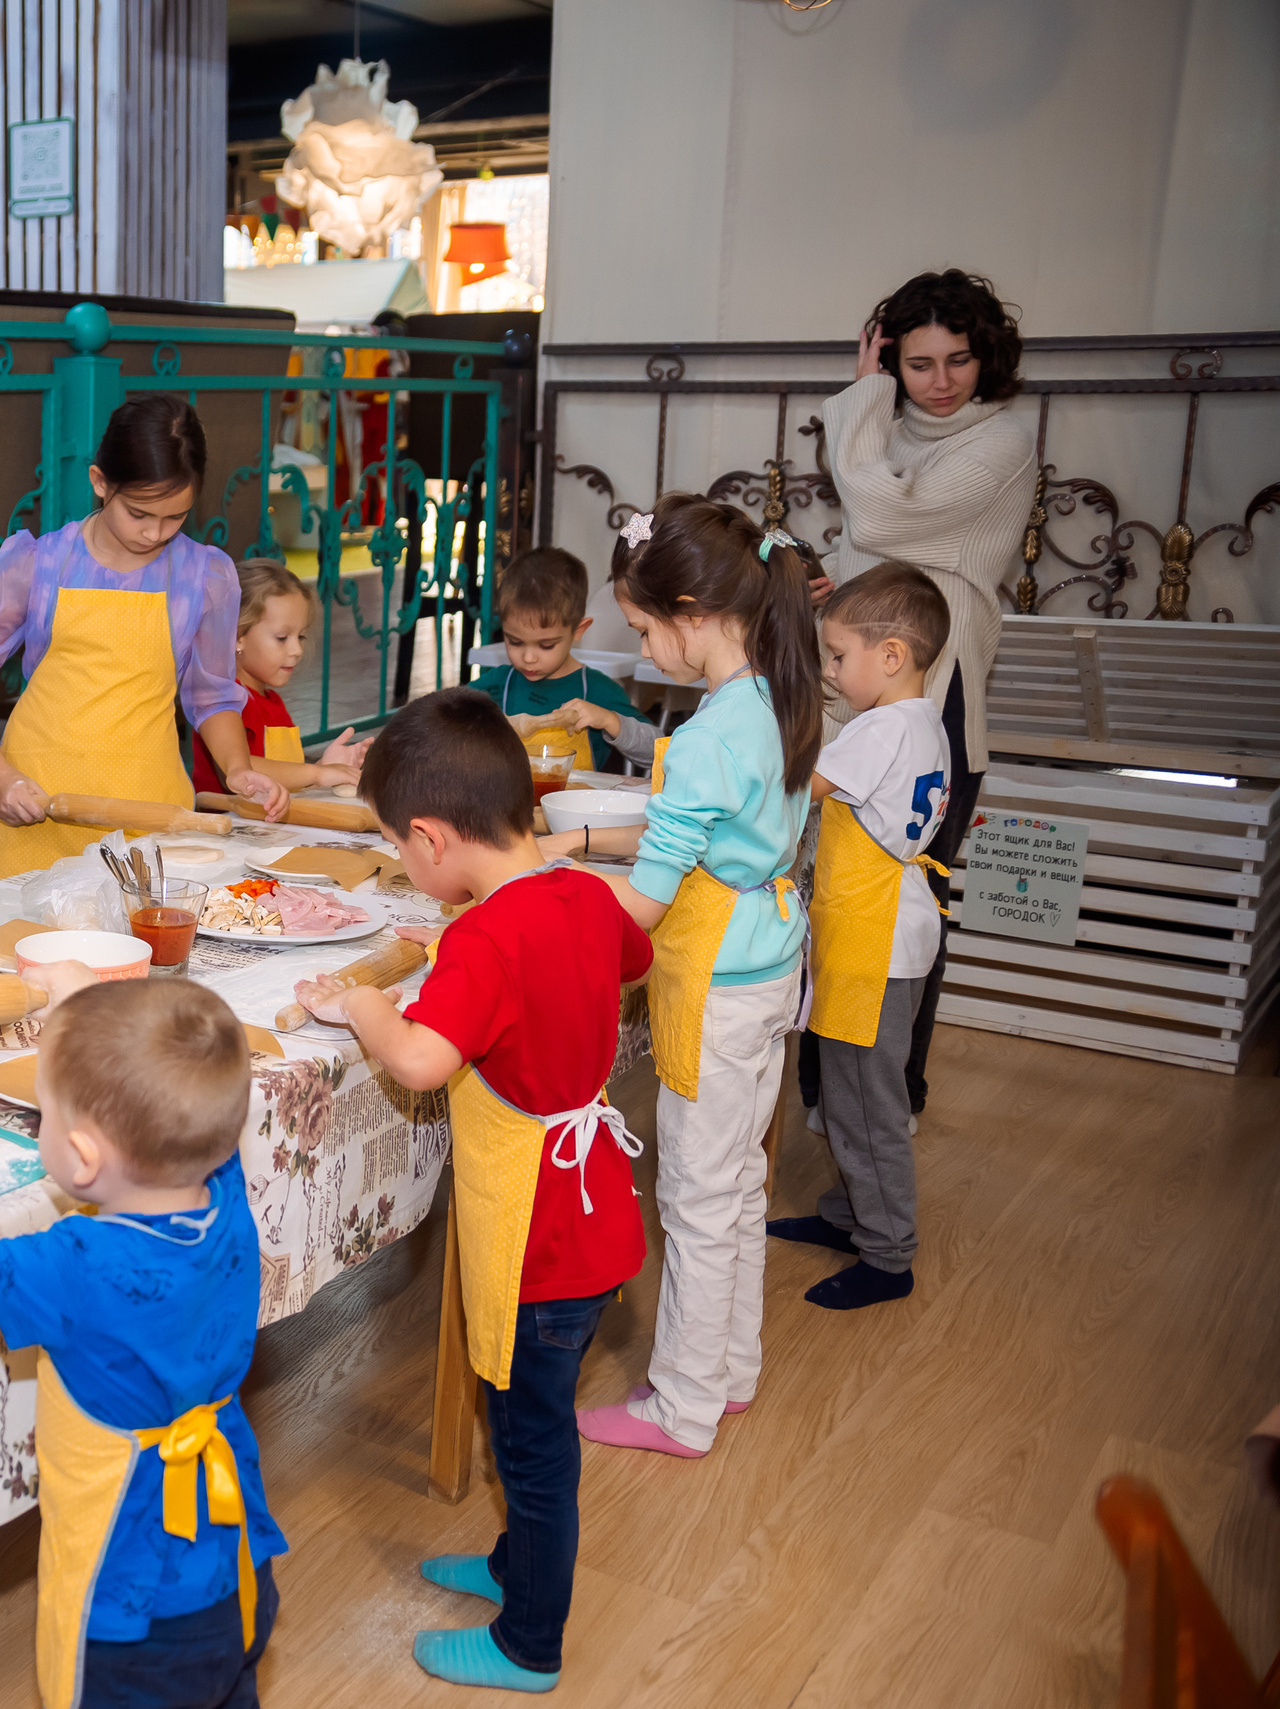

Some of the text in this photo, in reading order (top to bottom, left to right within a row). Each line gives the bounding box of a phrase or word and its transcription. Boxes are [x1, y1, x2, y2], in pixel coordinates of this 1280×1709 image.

[906, 770, 944, 841] 5
[977, 829, 1076, 852] Этот ящик для Вас!
[975, 844, 1078, 868] Вы можете сложить
[970, 860, 993, 870] свои
[996, 864, 1036, 878] подарки
[1050, 872, 1079, 883] вещи.
[980, 891, 984, 899] с
[988, 892, 1028, 905] заботой
[1043, 899, 1062, 912] Вас,
[992, 906, 1046, 923] ГОРОДОК
